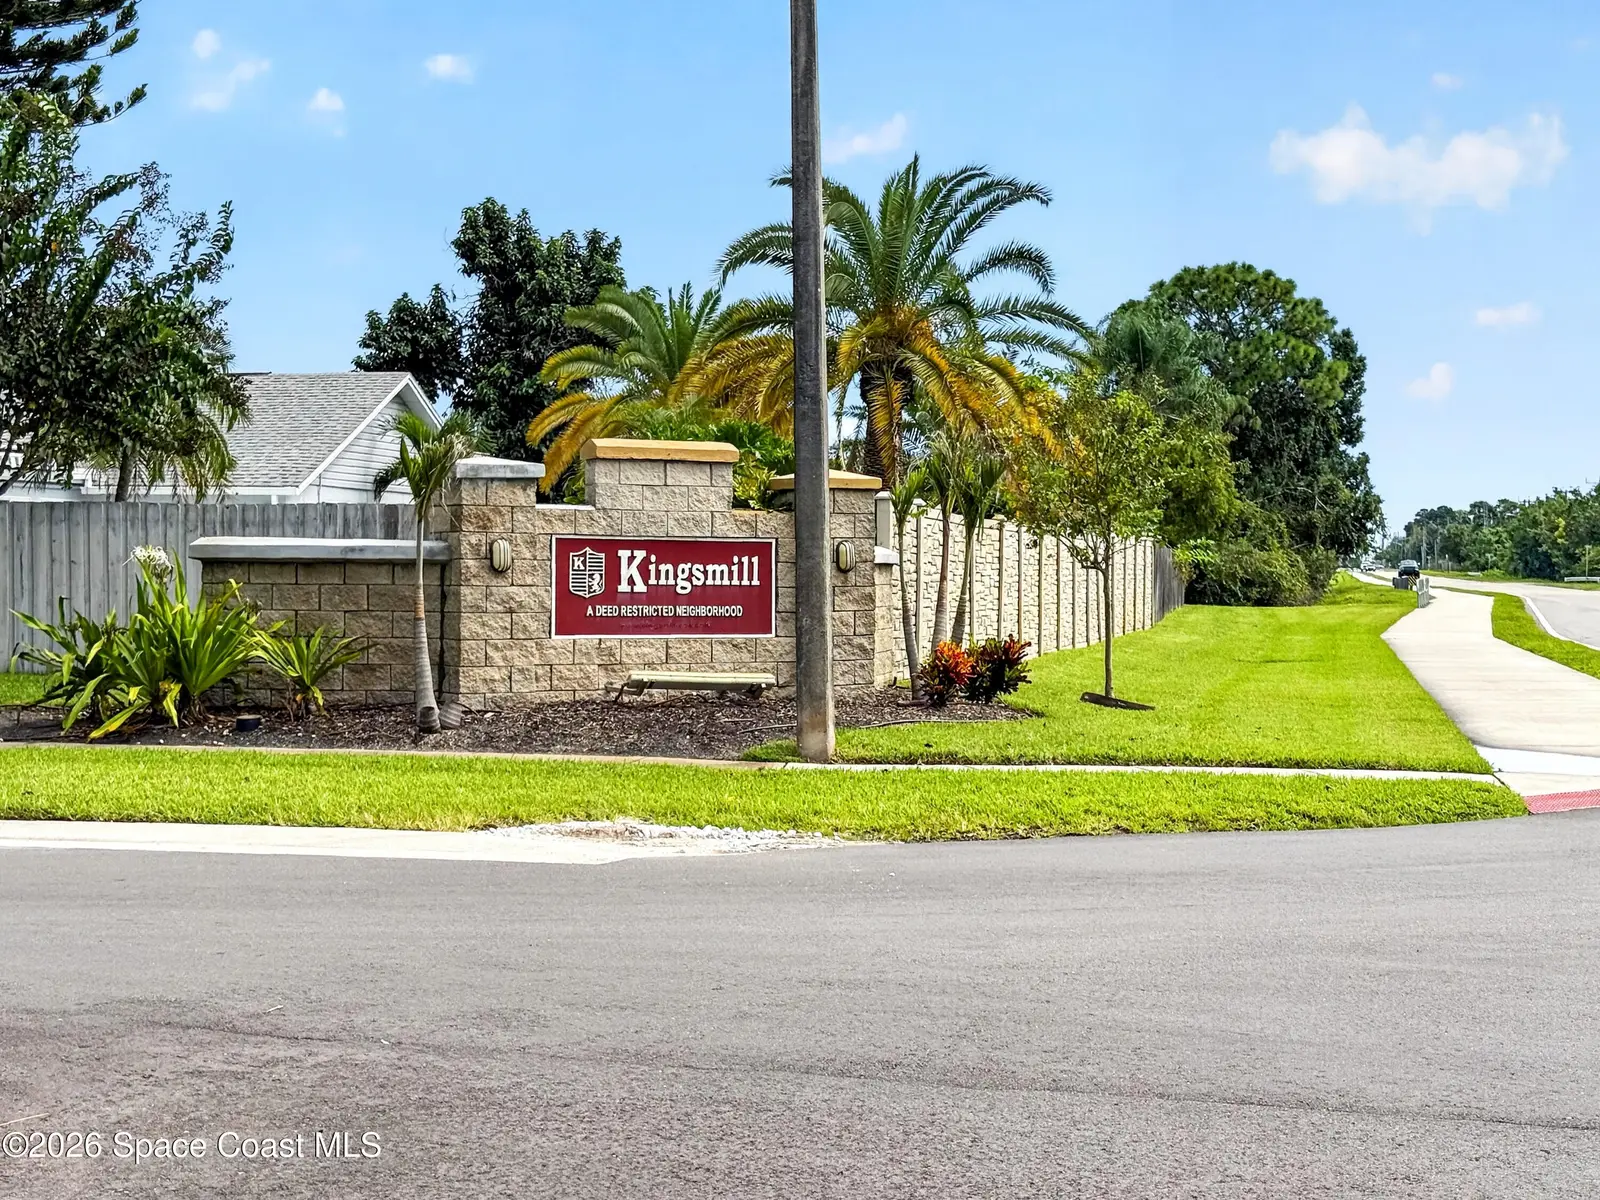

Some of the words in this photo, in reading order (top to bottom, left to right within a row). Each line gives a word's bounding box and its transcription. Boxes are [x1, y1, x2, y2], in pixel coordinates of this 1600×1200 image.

[573, 556, 585, 570] K
[617, 549, 761, 594] Kingsmill
[586, 605, 594, 617] A
[596, 605, 619, 617] DEED
[620, 605, 675, 617] RESTRICTED
[676, 605, 743, 617] NEIGHBORHOOD
